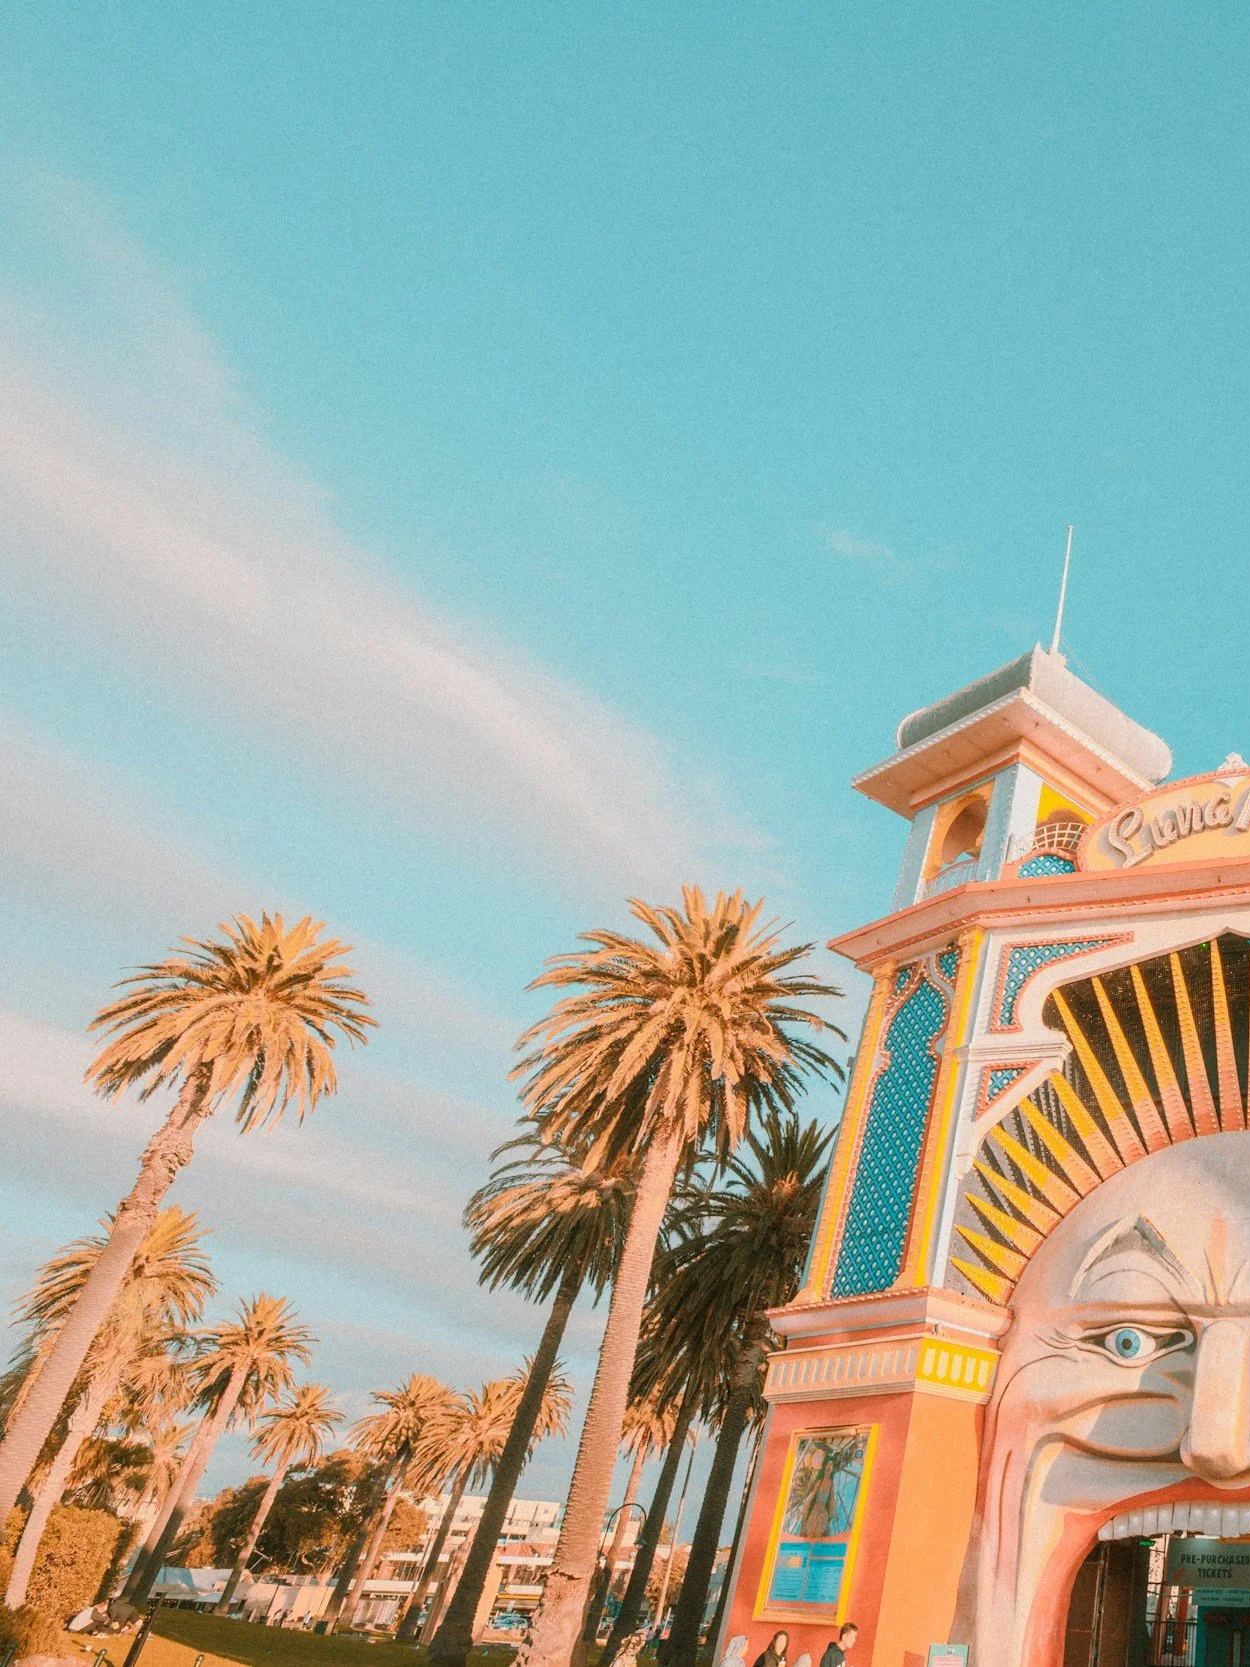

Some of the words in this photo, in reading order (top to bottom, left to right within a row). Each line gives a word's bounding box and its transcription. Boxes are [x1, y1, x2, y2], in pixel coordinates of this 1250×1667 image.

[1105, 791, 1234, 869] Luna
[1180, 1553, 1250, 1565] PRE-PURCHASED
[1197, 1568, 1233, 1579] TICKETS
